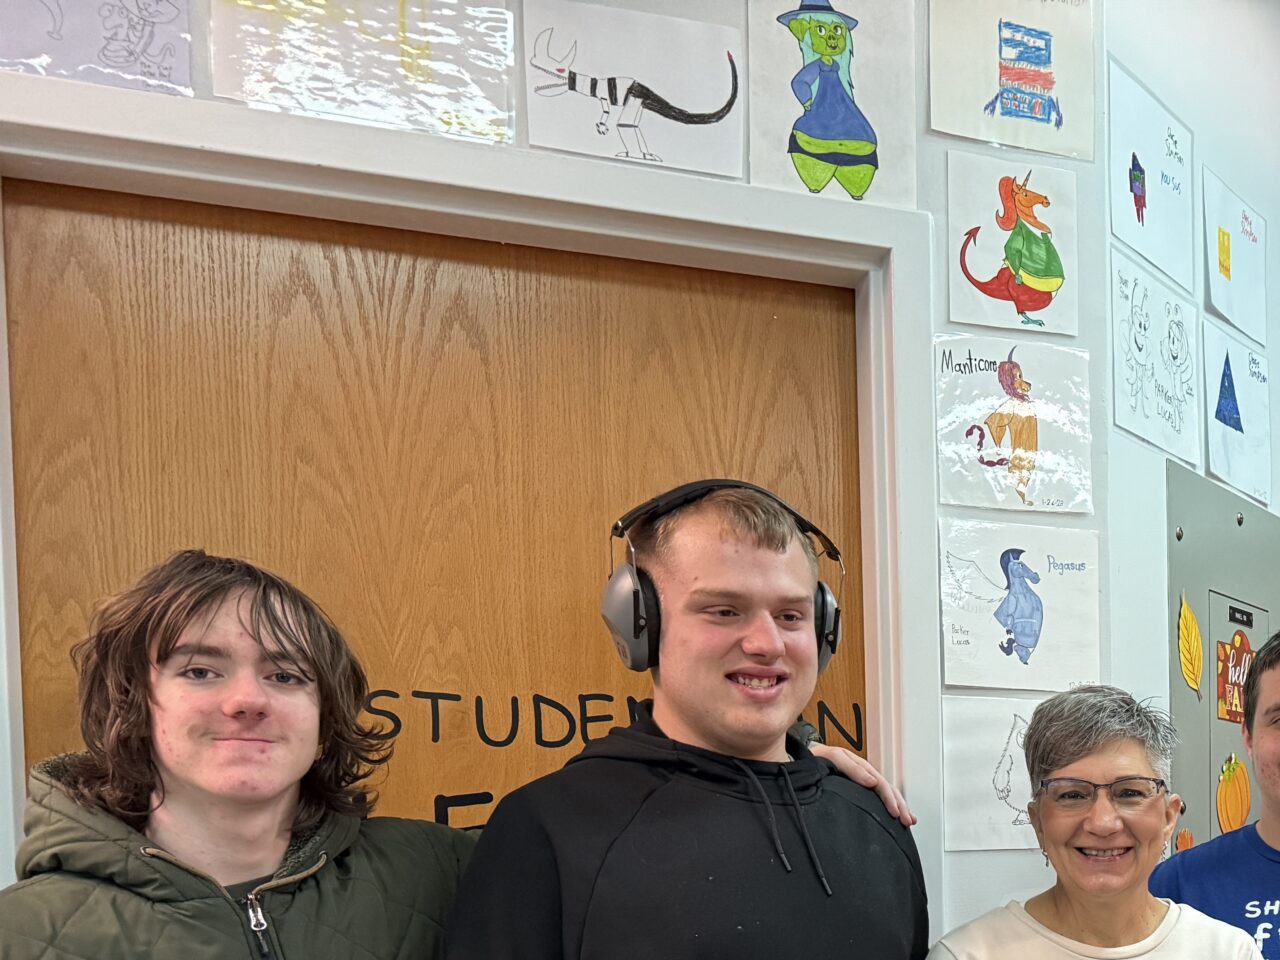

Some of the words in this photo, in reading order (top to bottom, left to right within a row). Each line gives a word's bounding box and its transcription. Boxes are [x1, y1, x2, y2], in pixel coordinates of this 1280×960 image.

[1047, 555, 1086, 575] Pegasus
[1228, 649, 1252, 685] hell
[1226, 684, 1244, 712] FA
[365, 690, 652, 748] STUDE
